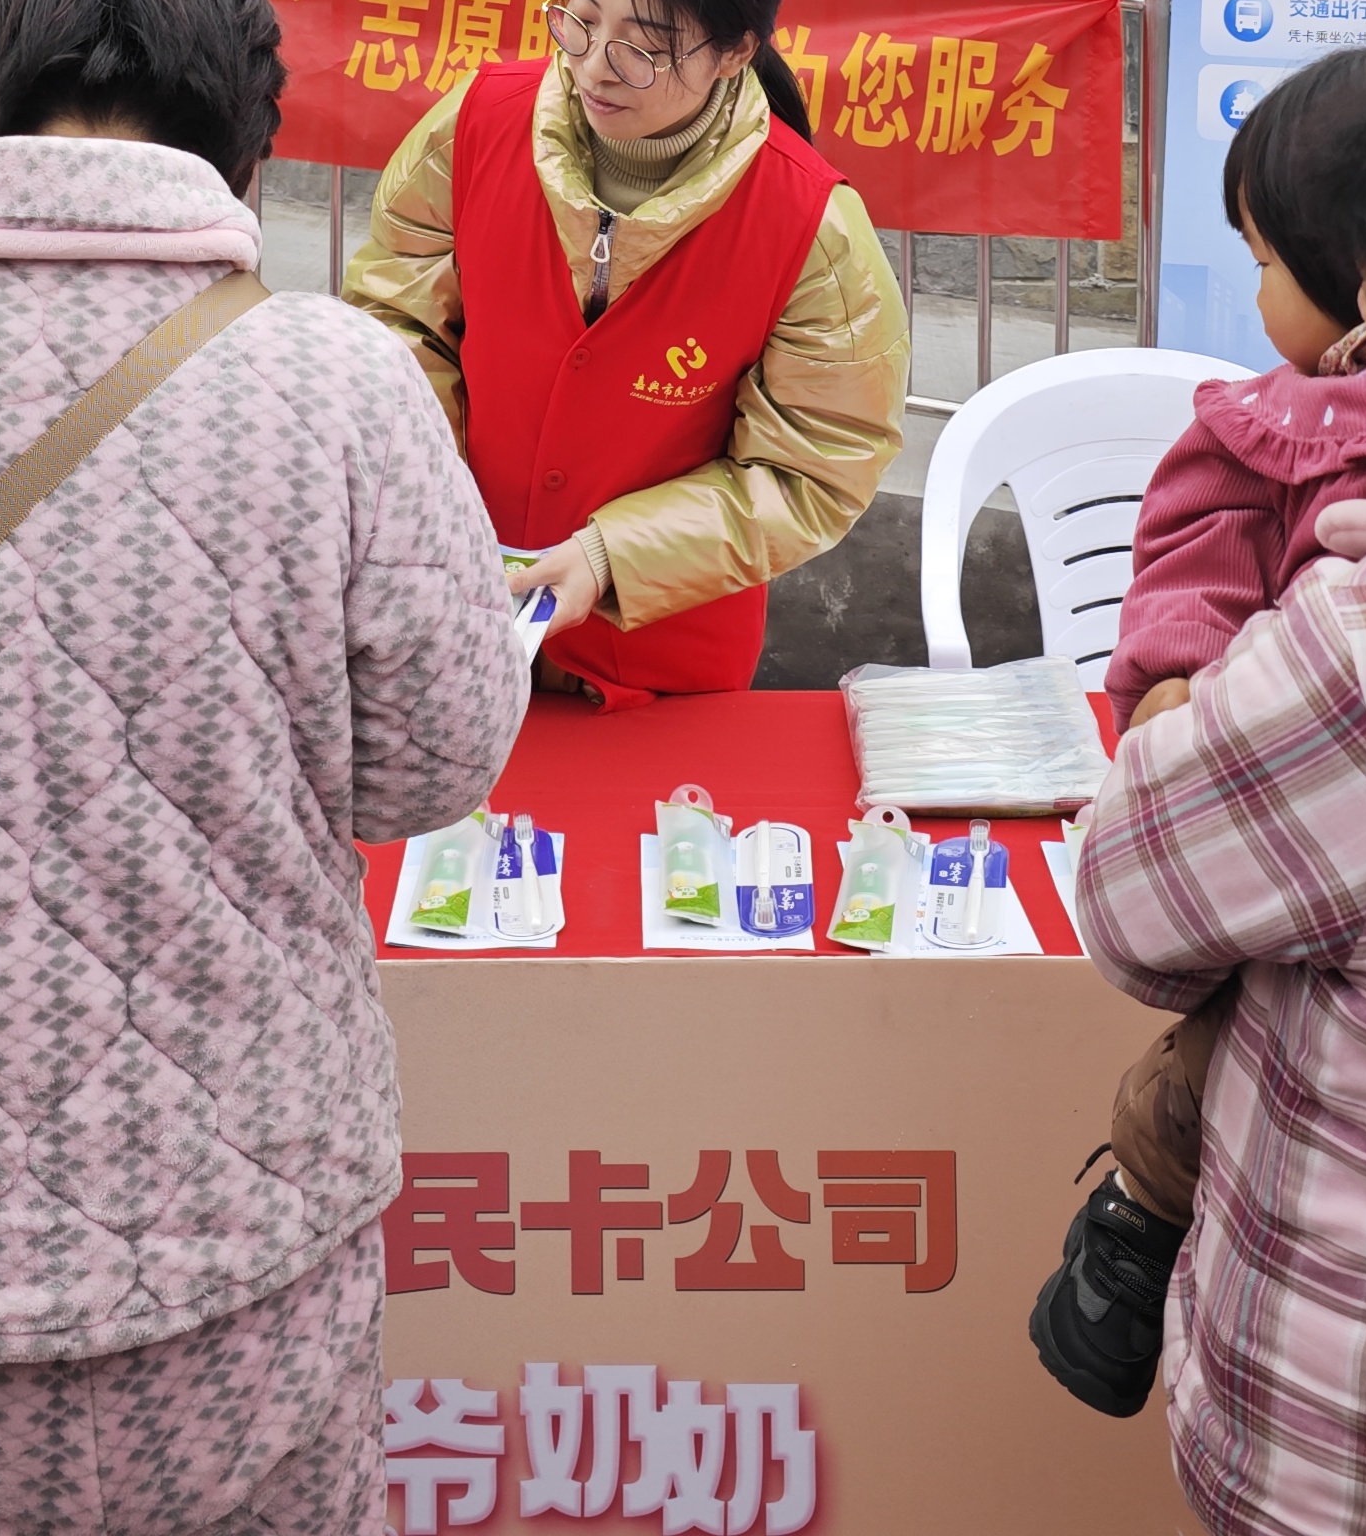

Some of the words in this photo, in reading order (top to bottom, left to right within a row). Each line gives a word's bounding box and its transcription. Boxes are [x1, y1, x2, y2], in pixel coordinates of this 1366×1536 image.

[383, 1149, 959, 1296] 民卡公司
[384, 1361, 819, 1536] 爷奶奶
